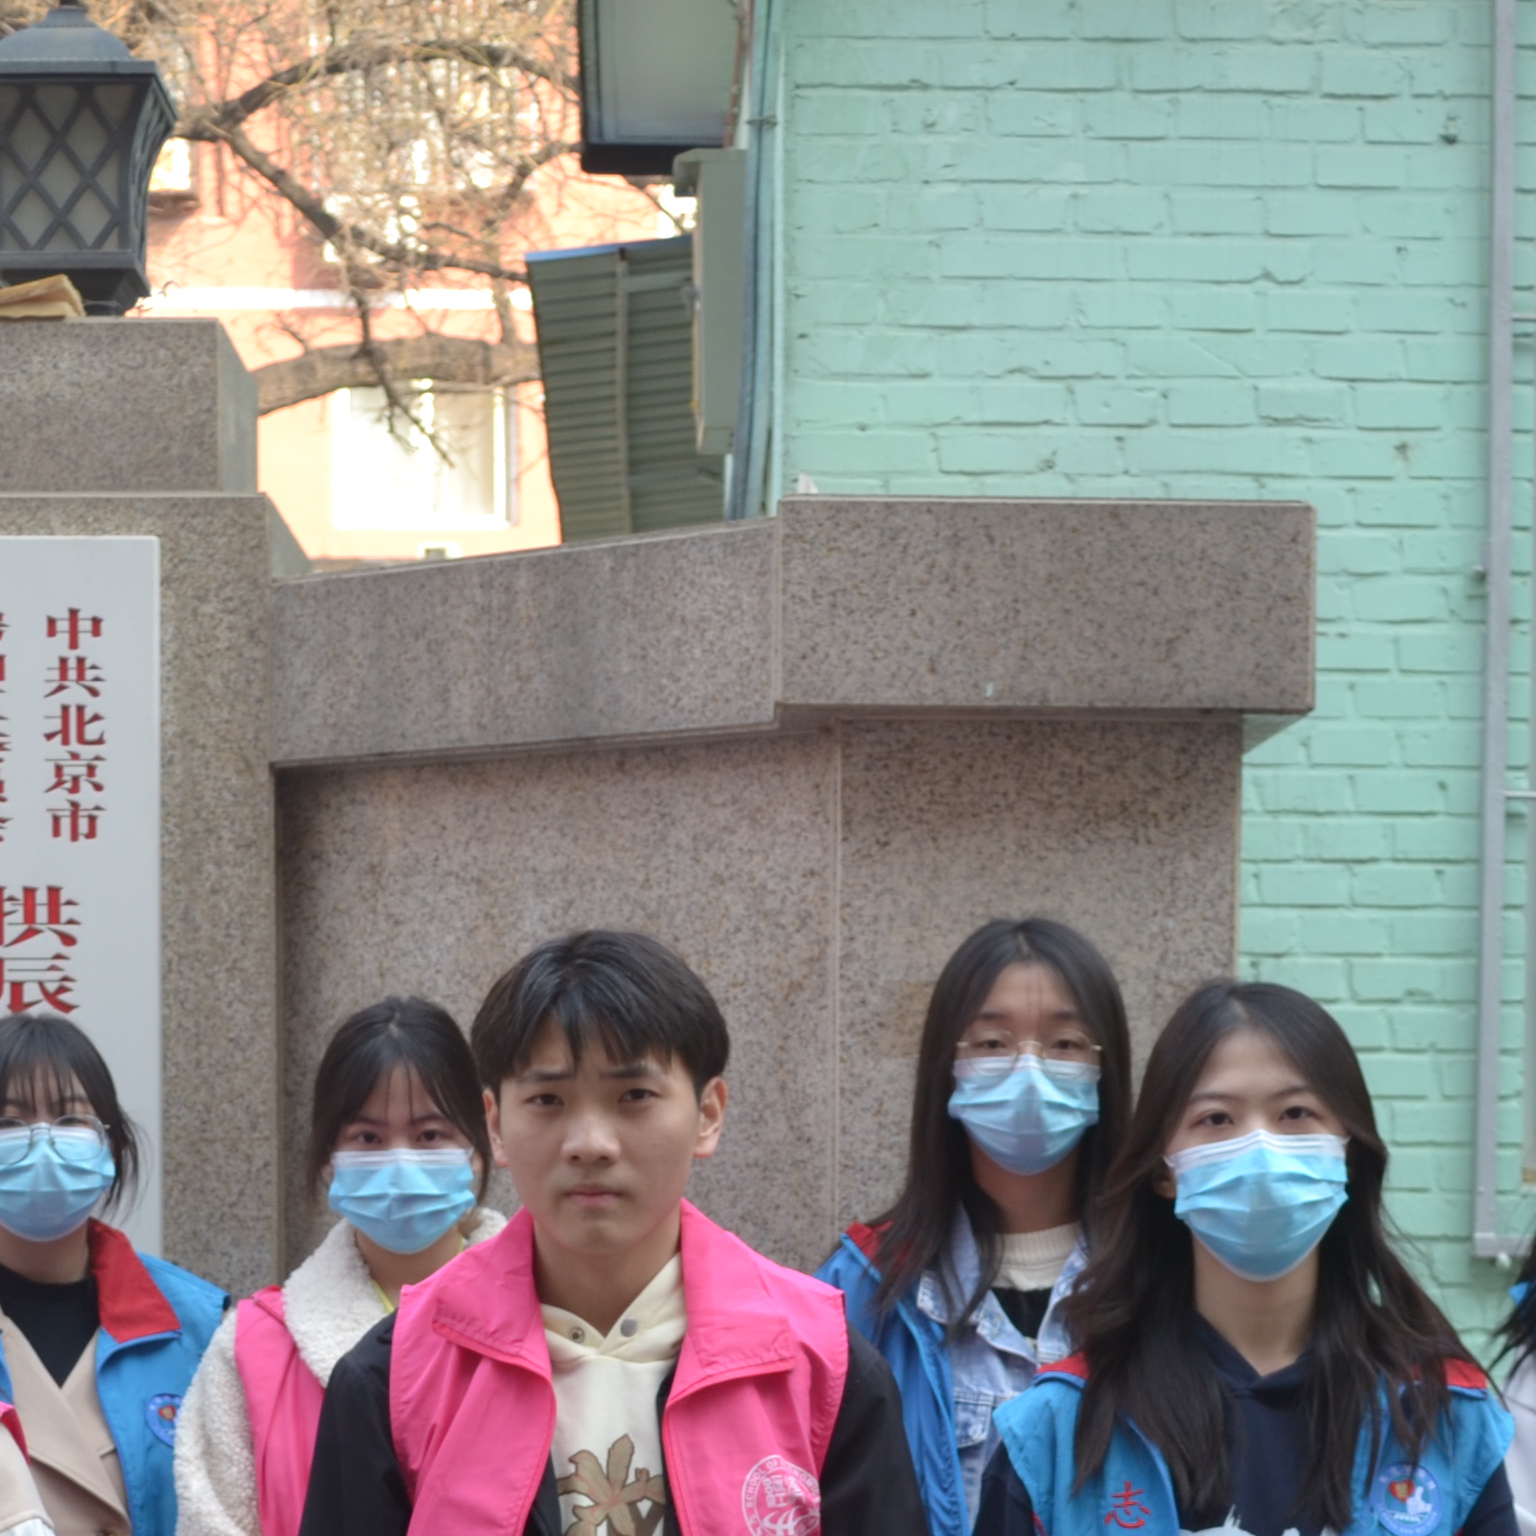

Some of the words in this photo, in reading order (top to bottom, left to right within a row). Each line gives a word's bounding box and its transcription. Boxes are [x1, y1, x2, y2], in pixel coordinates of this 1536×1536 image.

[44, 607, 107, 842] 中共北京市
